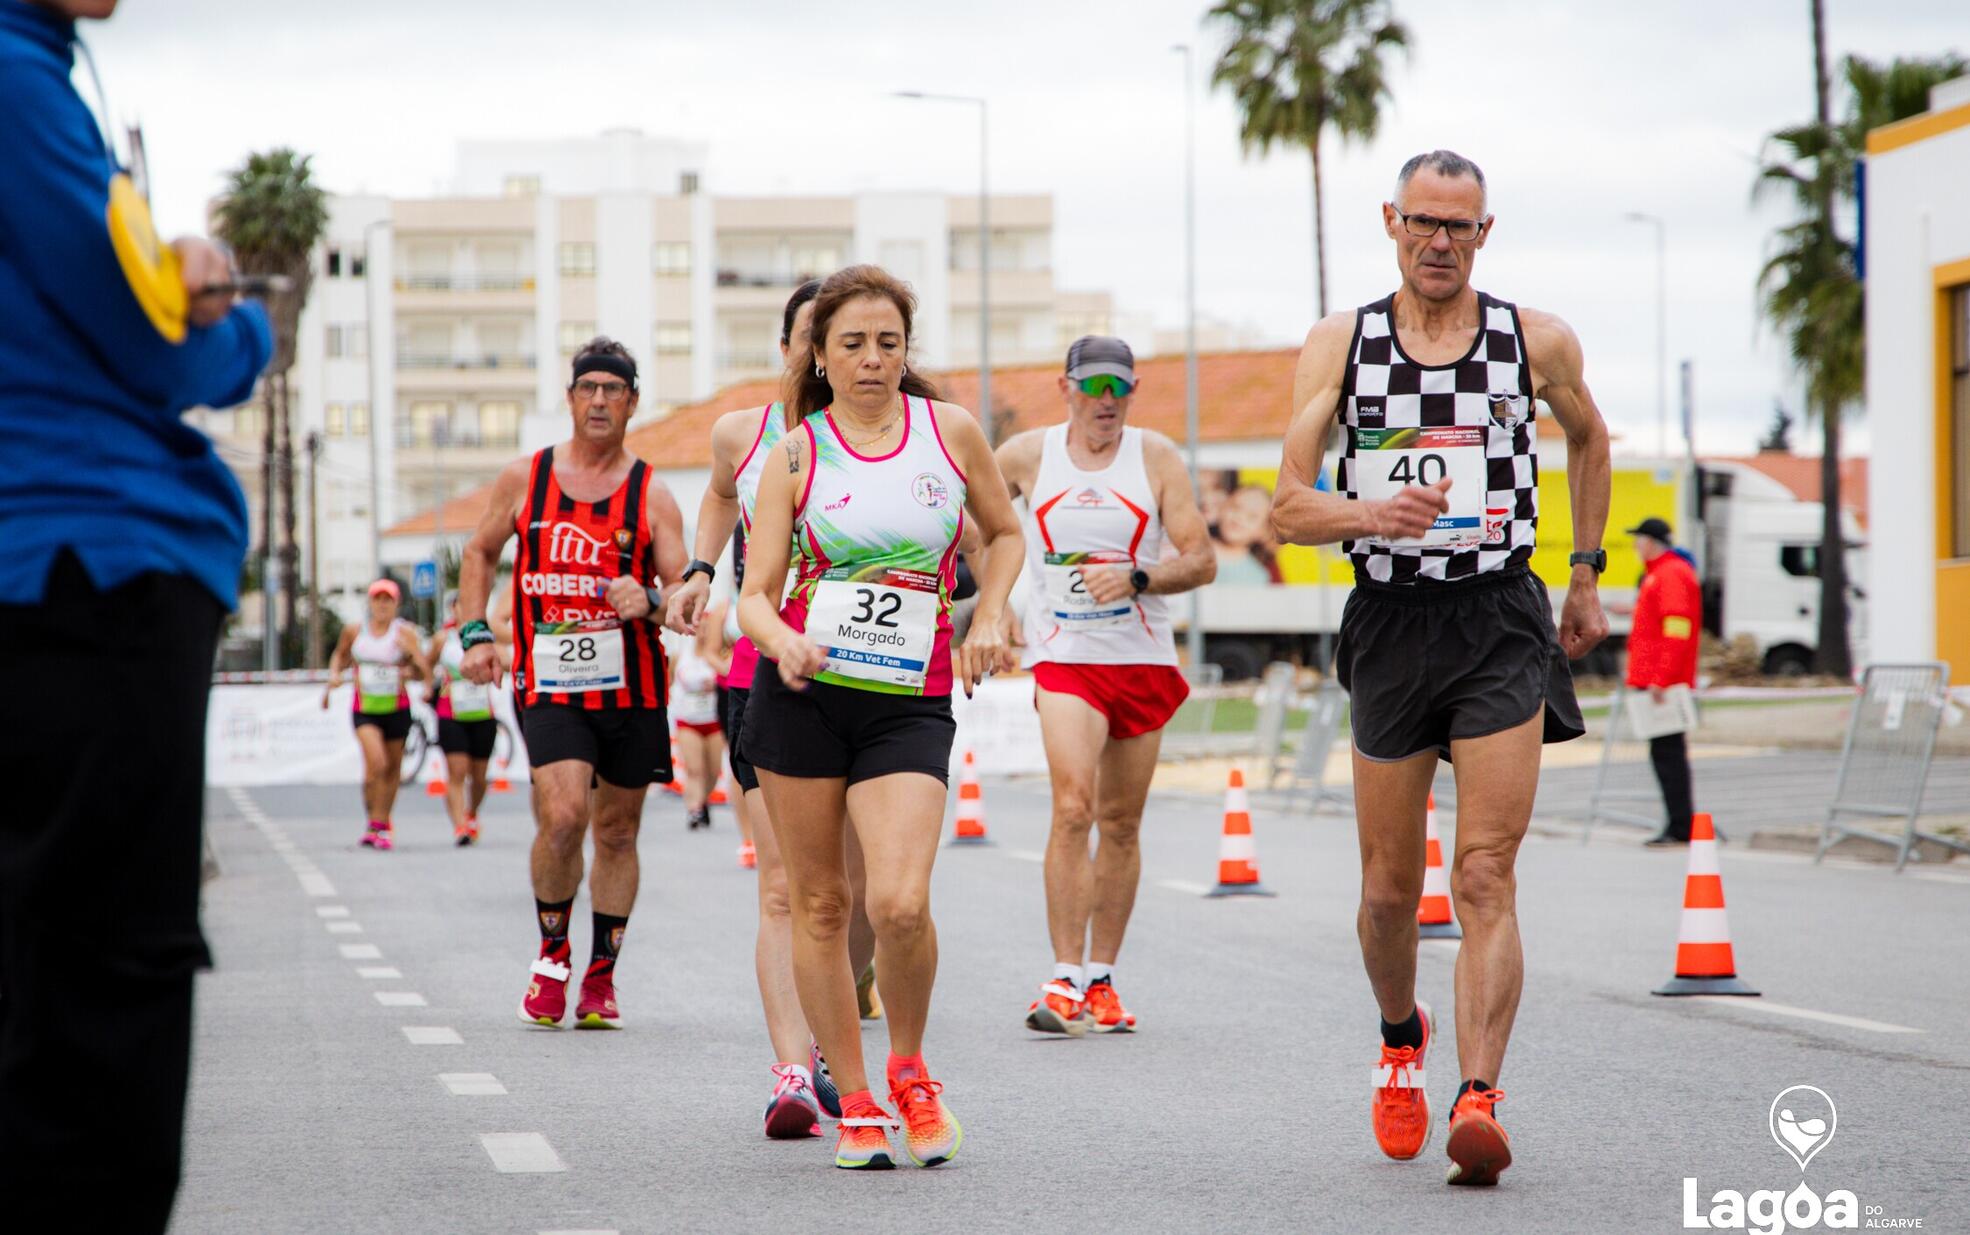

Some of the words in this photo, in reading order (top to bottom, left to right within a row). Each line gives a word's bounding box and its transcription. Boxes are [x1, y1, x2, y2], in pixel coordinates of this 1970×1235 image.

[1388, 453, 1447, 487] 40
[521, 573, 612, 598] COBER
[851, 588, 903, 628] 32
[837, 623, 906, 647] Morgado
[560, 637, 597, 662] 28
[837, 649, 848, 658] 20
[849, 651, 863, 661] Km
[865, 653, 881, 664] Vet
[883, 657, 901, 666] Fem
[558, 663, 599, 673] Oliveira
